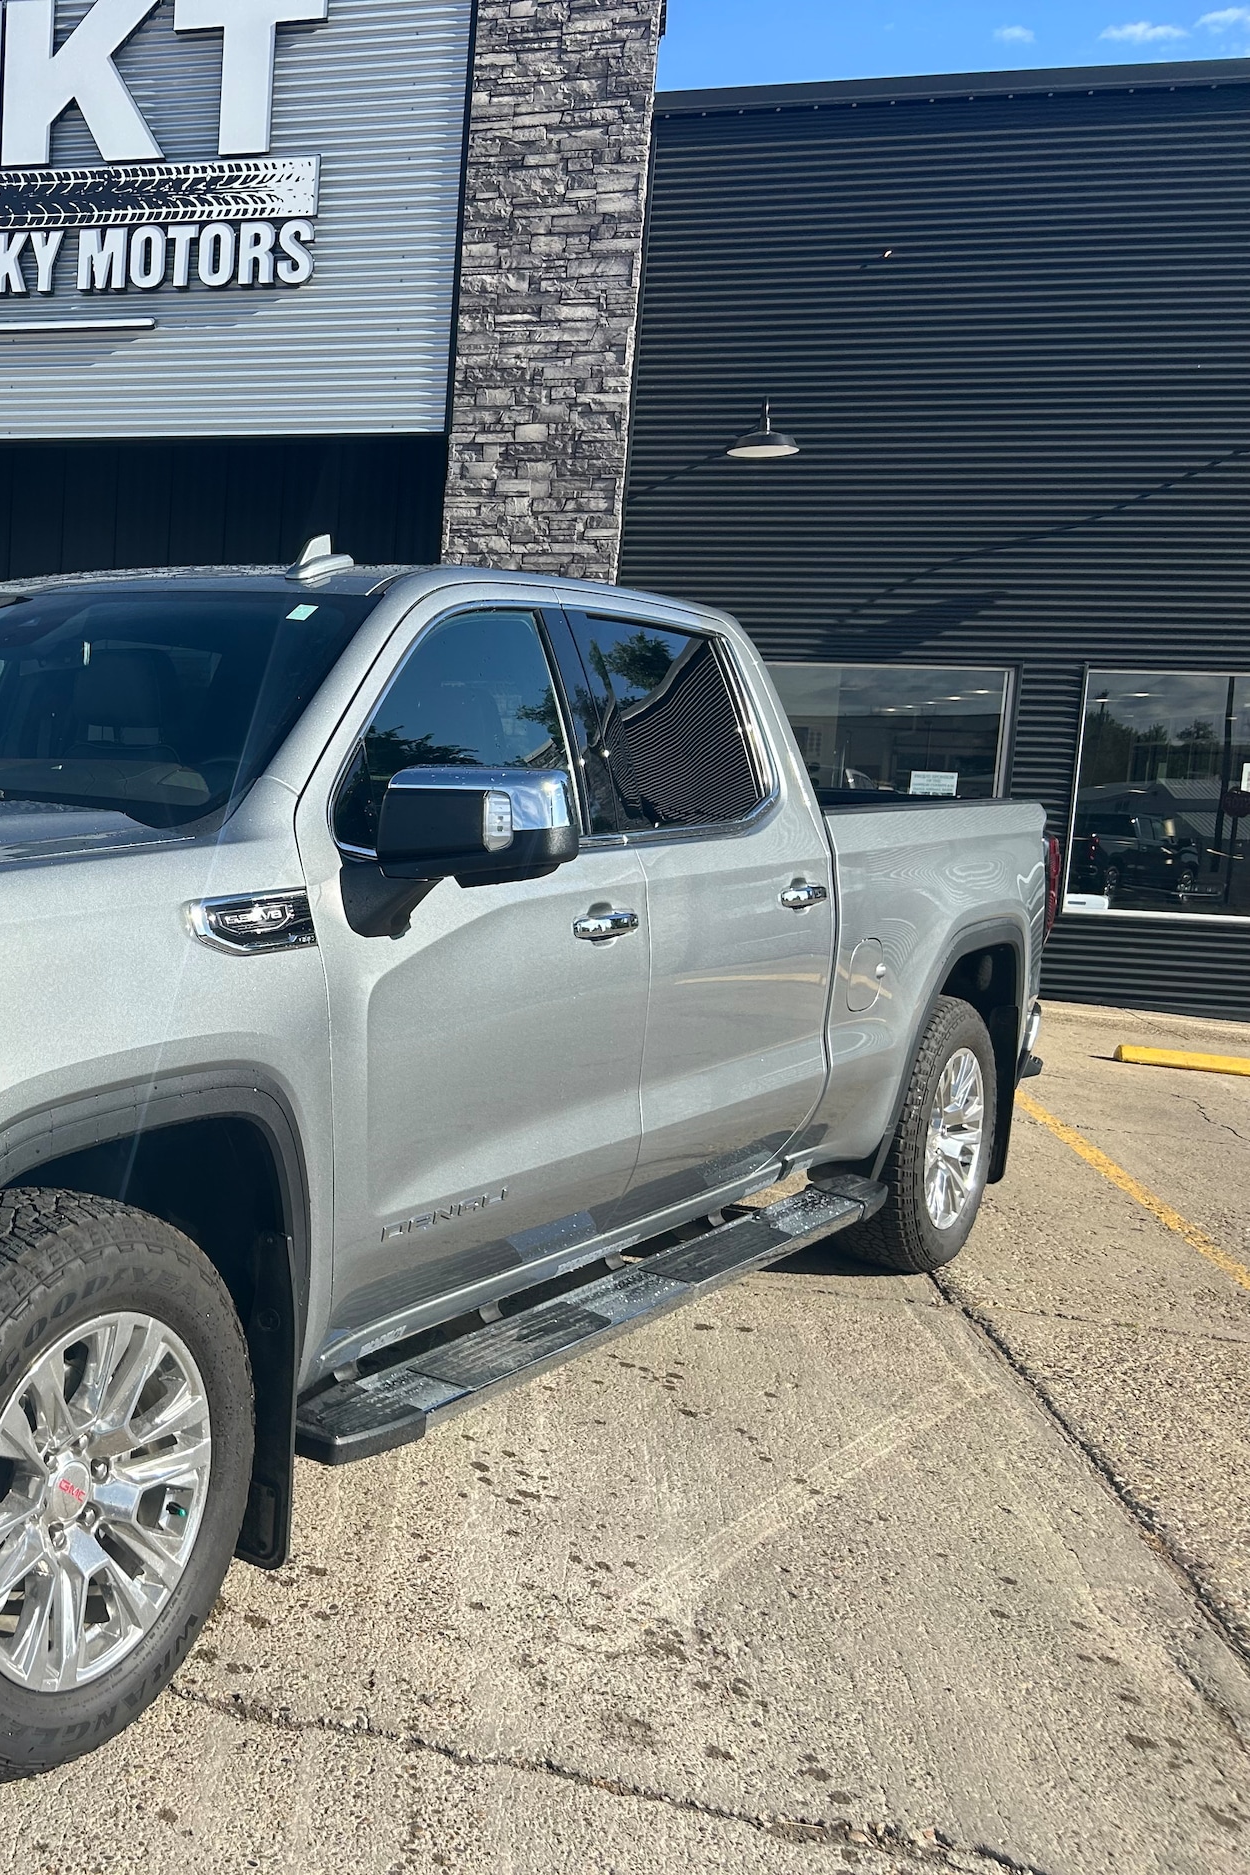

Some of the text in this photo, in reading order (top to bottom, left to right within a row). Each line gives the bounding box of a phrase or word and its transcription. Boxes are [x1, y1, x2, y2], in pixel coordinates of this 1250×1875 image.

[76, 219, 317, 292] MOTORS
[380, 1185, 509, 1242] DENALI
[58, 1478, 86, 1503] GMC
